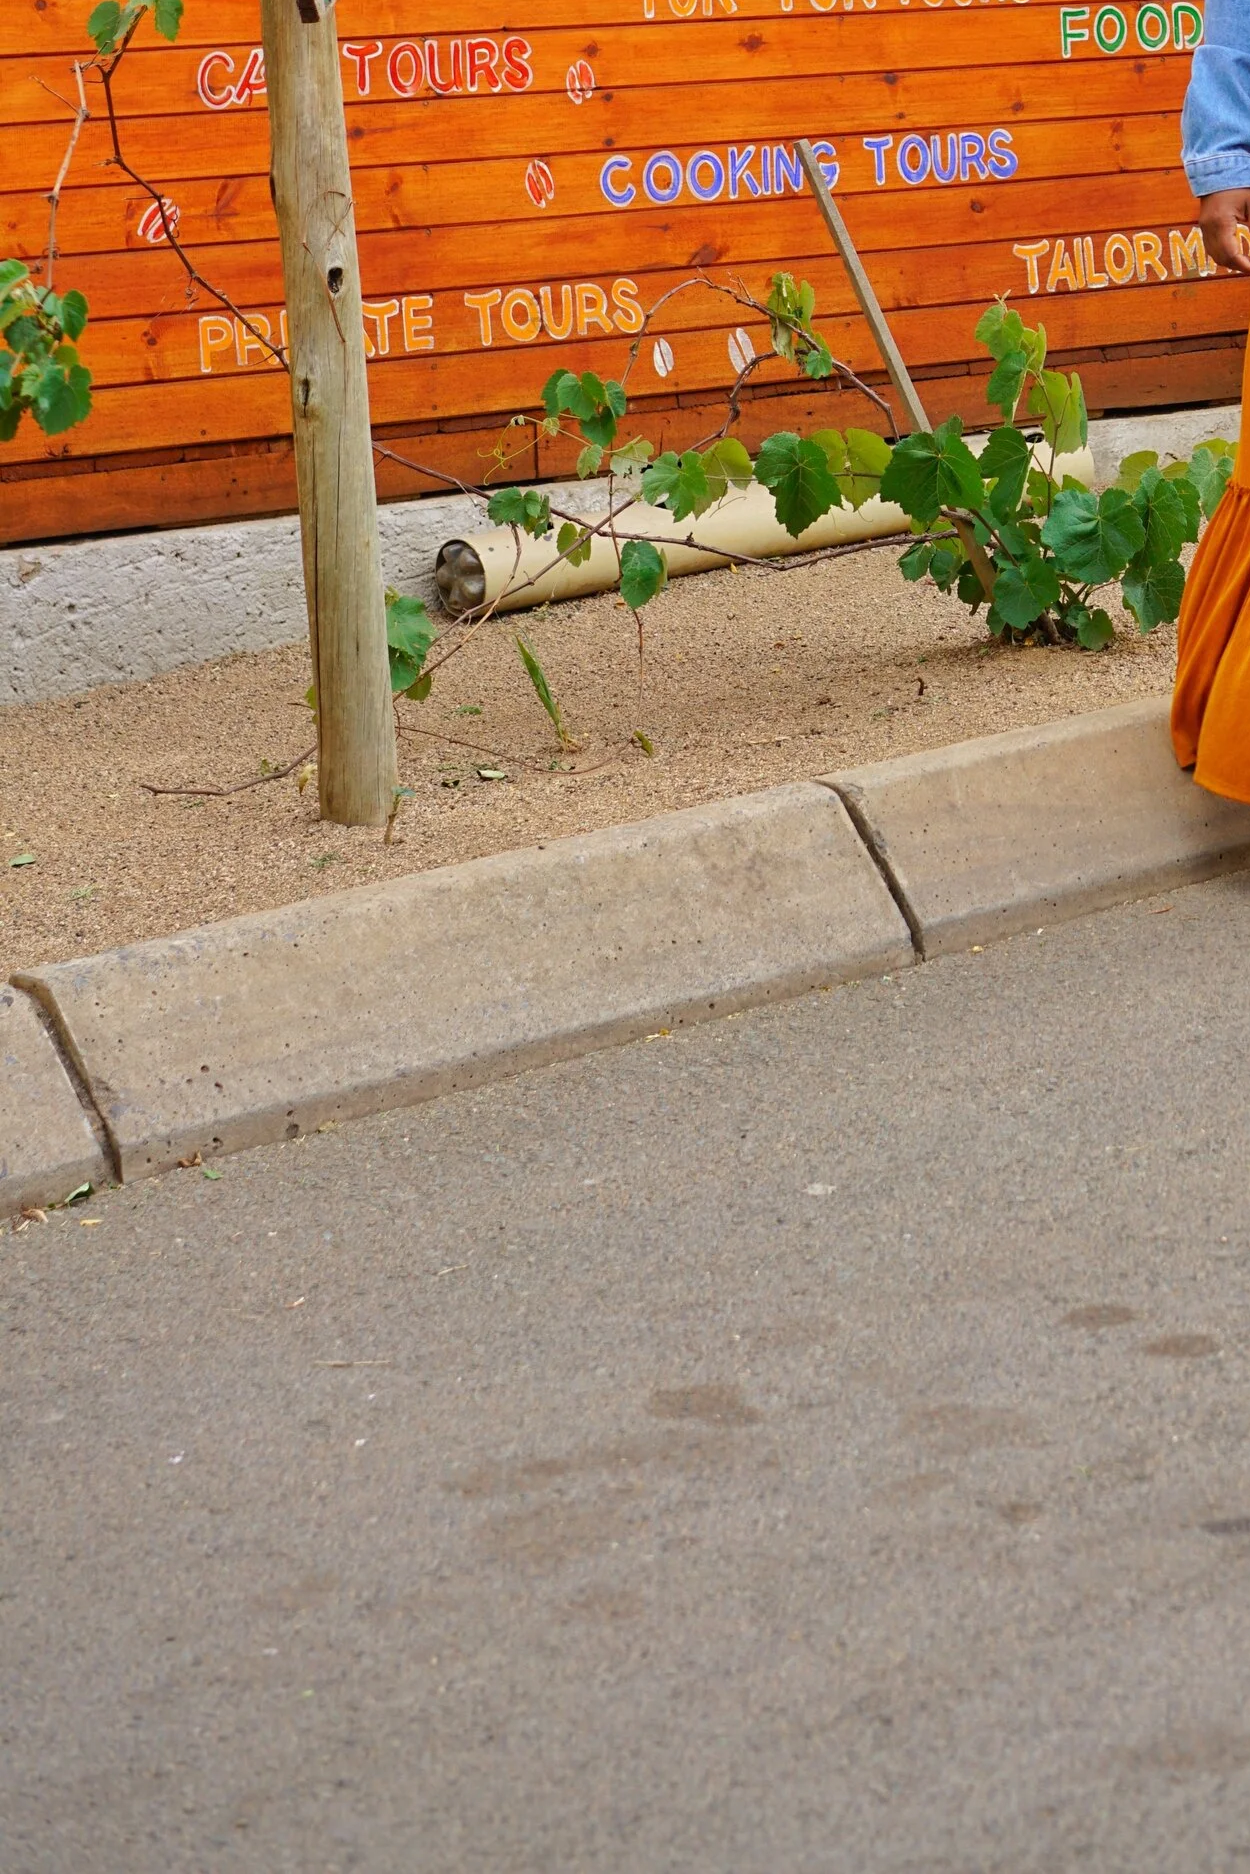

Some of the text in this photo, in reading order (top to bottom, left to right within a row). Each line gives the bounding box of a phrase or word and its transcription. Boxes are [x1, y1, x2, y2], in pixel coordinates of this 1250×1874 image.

[1060, 2, 1203, 58] FOOD
[343, 37, 533, 98] TOURS
[600, 129, 1019, 207] COOKING TOURS
[465, 278, 645, 346] TOURS
